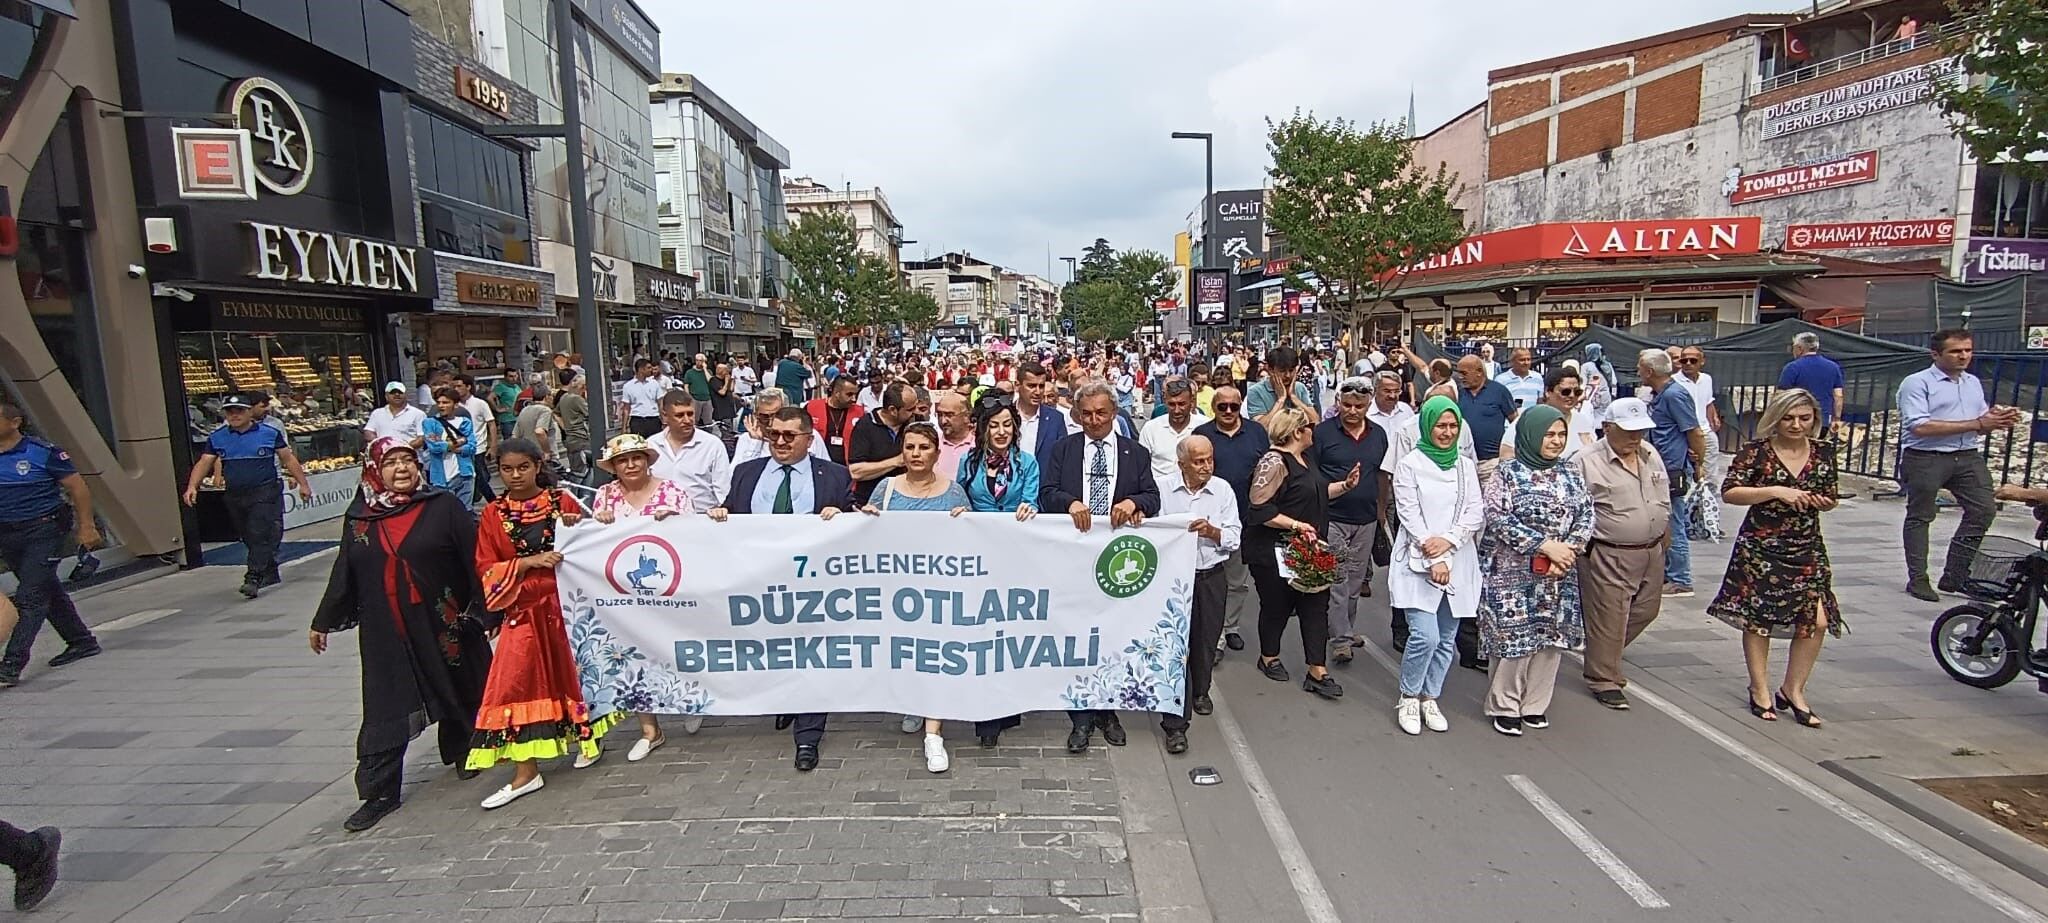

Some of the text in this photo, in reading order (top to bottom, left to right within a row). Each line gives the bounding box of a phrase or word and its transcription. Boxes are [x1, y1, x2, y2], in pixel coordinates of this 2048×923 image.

[474, 77, 507, 112] 1953
[1766, 101, 1811, 120] DÜZCE
[1816, 88, 1846, 106] TÜM
[1775, 111, 1837, 135] DERNEK
[193, 144, 234, 184] E
[1744, 157, 1869, 193] TOMBUL METİN
[1218, 199, 1262, 215] CAHİT
[1600, 224, 1739, 252] ALTAN
[1813, 223, 1934, 243] MANAV HÜSEYİN
[248, 222, 418, 292] EYMEN
[221, 301, 273, 318] EYMEN
[1465, 306, 1495, 316] ALTAN
[1550, 302, 1594, 312] ALTAN
[302, 487, 353, 510] DIAMOND
[793, 554, 989, 579] 7. GELENEKSEL
[595, 598, 697, 608] Düzce Belediyesi
[728, 584, 1050, 626] DÜZCE OTLARI
[674, 627, 1099, 676] BEREKET FESTİVALİ
